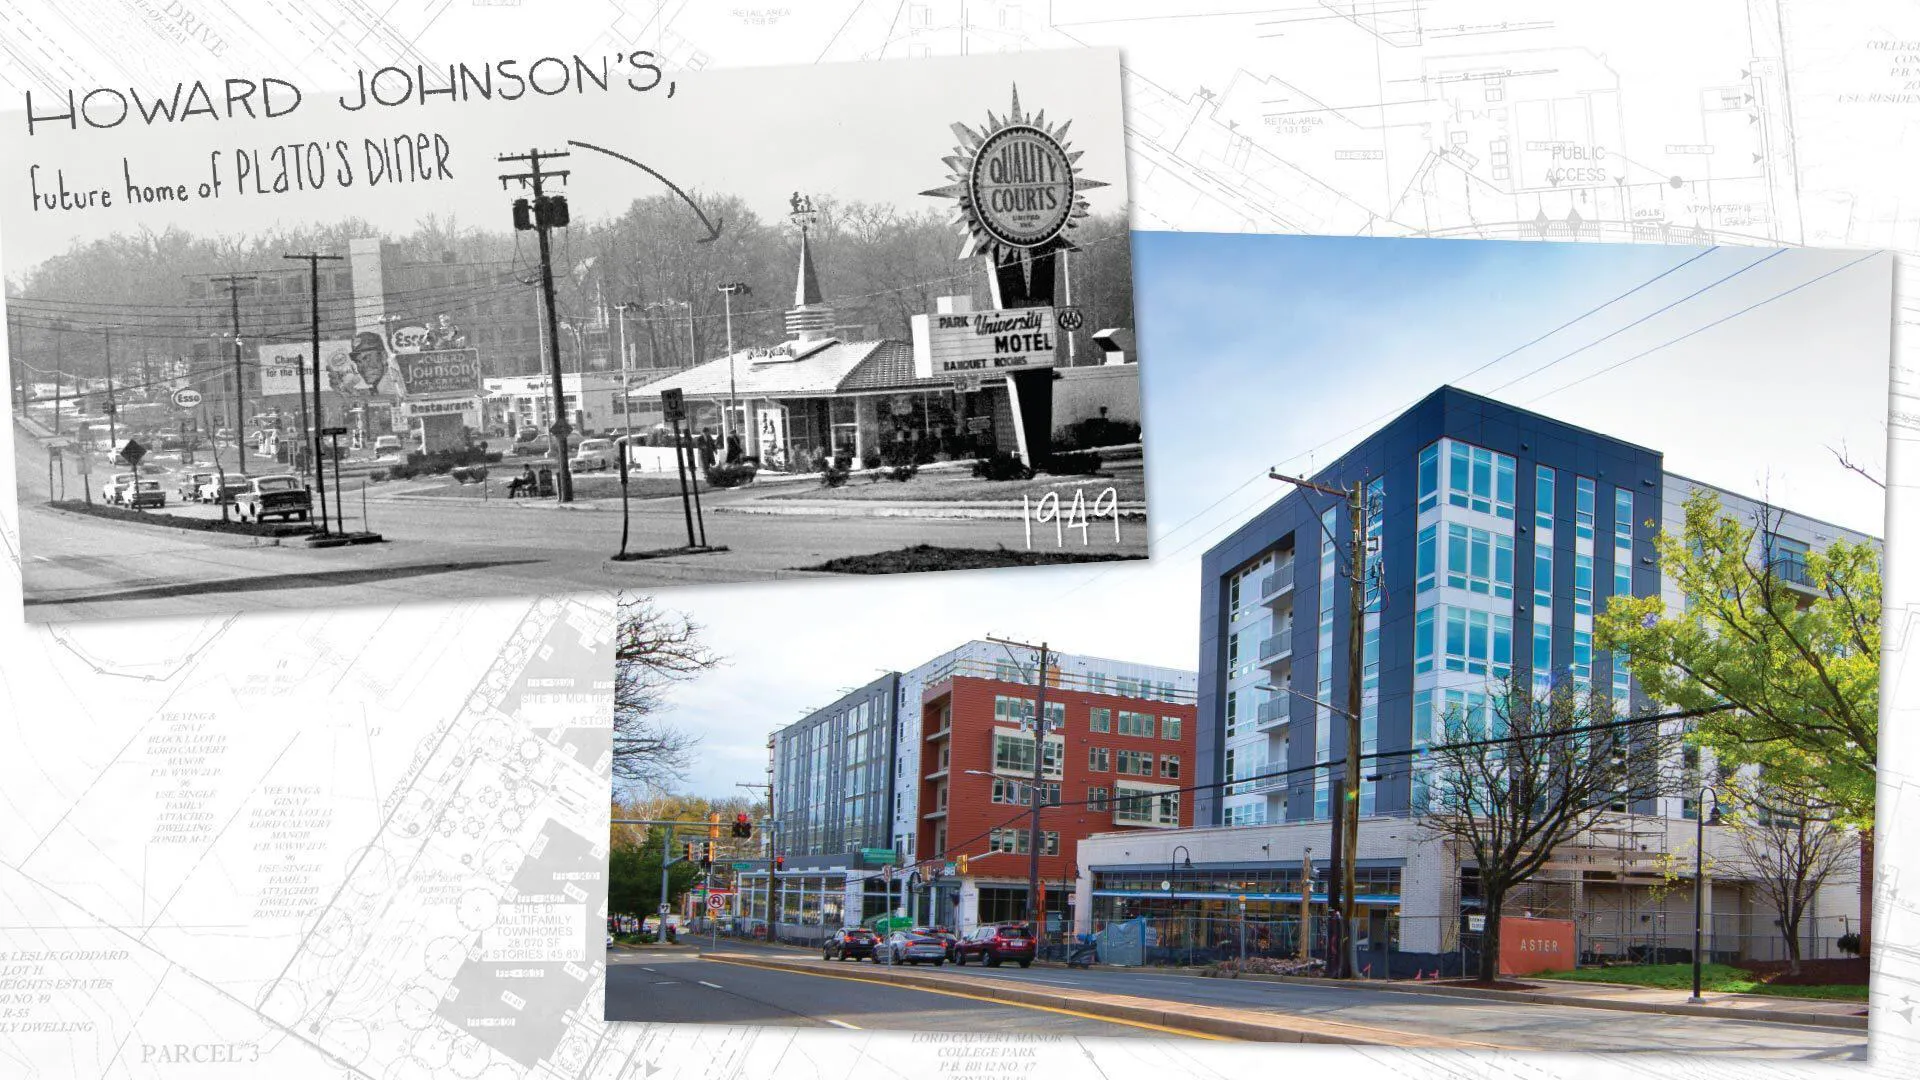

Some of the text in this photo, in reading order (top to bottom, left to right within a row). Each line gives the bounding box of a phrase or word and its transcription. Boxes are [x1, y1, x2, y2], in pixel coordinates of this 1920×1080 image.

[1552, 146, 1605, 160] PUBLIC
[990, 142, 1057, 184] QUALITY
[1546, 168, 1606, 181] ACCESS
[992, 187, 1058, 213] COURTS
[939, 310, 1043, 336] PARK University
[1061, 312, 1080, 327] AAA
[995, 333, 1053, 353] MOTEL
[275, 355, 303, 365] Chang
[943, 356, 1027, 371] BANQUET ROOMS
[177, 392, 201, 404] Esso
[411, 401, 475, 414] Restaurant
[669, 400, 678, 410] U
[168, 757, 205, 765] MANOR
[165, 802, 204, 810] FAMILY
[157, 824, 213, 832] DWELLING
[282, 820, 331, 828] CALVERT
[262, 887, 319, 895] ATTACHED
[261, 898, 317, 906] DWELLING
[514, 904, 539, 914] SITE
[496, 915, 572, 925] MULTIFAMILY
[497, 927, 574, 937] TOWNHOMES
[547, 938, 560, 948] SF
[1520, 939, 1559, 952] ASTER
[11, 952, 57, 961] LESLIE
[60, 951, 129, 960] GODDARD
[493, 949, 543, 960] STORIES
[3, 966, 29, 976] LOT
[55, 979, 114, 989] ESTATES
[21, 1022, 93, 1032] DWELLING
[141, 1044, 241, 1063] PARCEL
[250, 1044, 260, 1063] 3
[938, 1047, 1037, 1057] COLLEGE PARK
